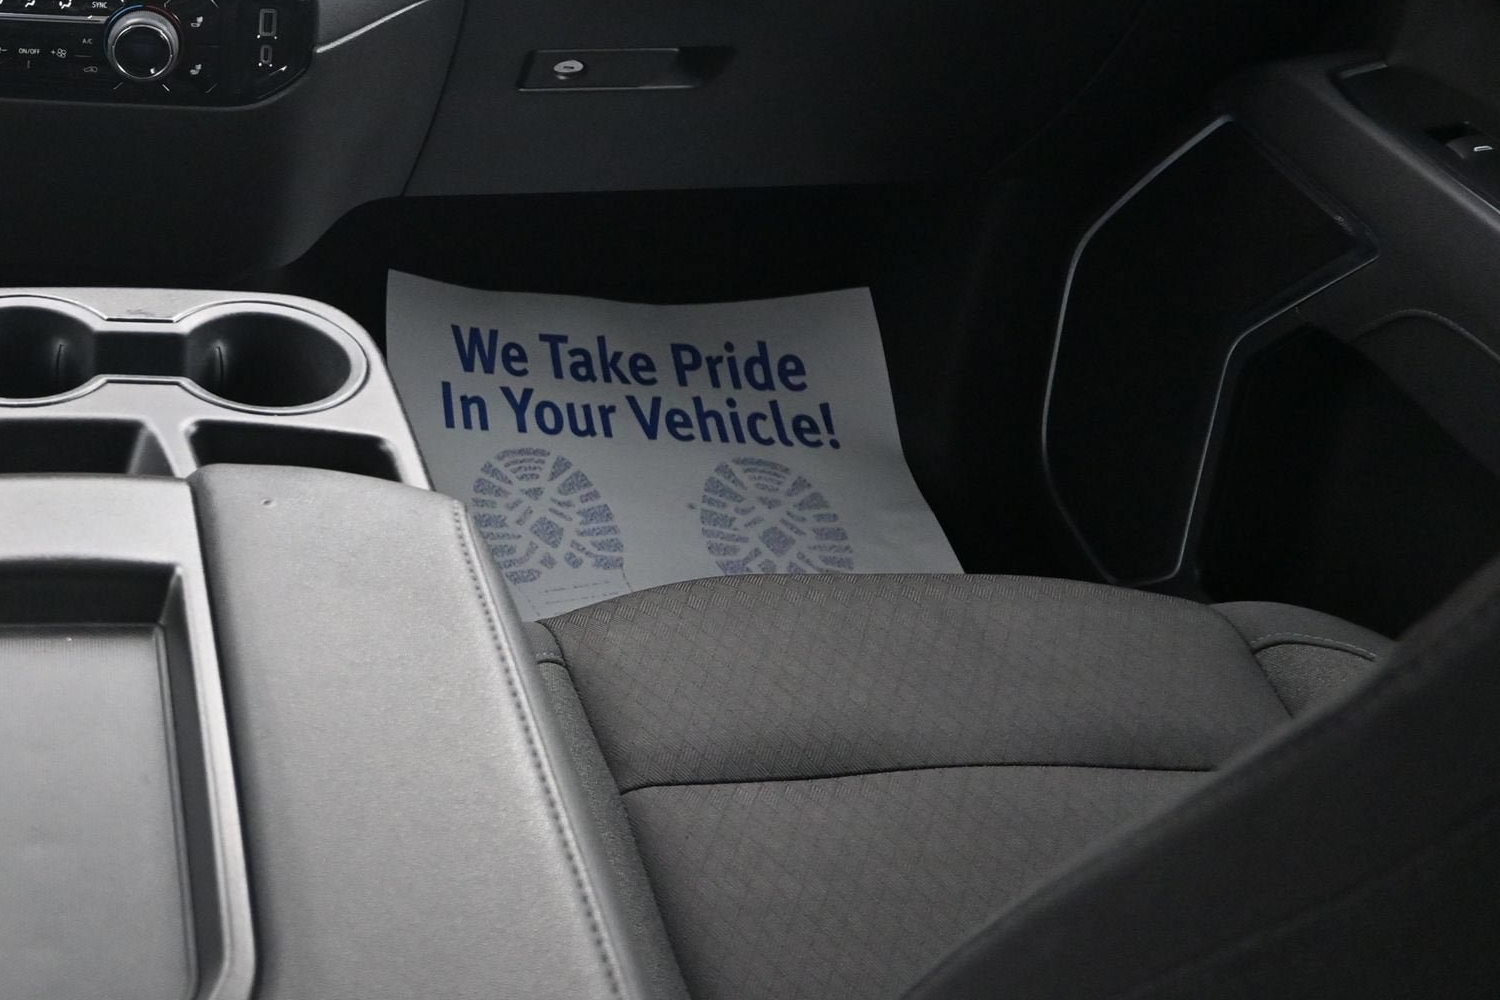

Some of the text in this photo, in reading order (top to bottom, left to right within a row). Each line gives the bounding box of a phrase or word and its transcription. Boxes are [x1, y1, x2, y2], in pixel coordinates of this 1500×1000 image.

[91, 1, 108, 9] SYNC
[18, 47, 41, 56] ON/OFF
[451, 324, 807, 392] We Take Pride
[441, 381, 841, 450] In Your Vehicle!
